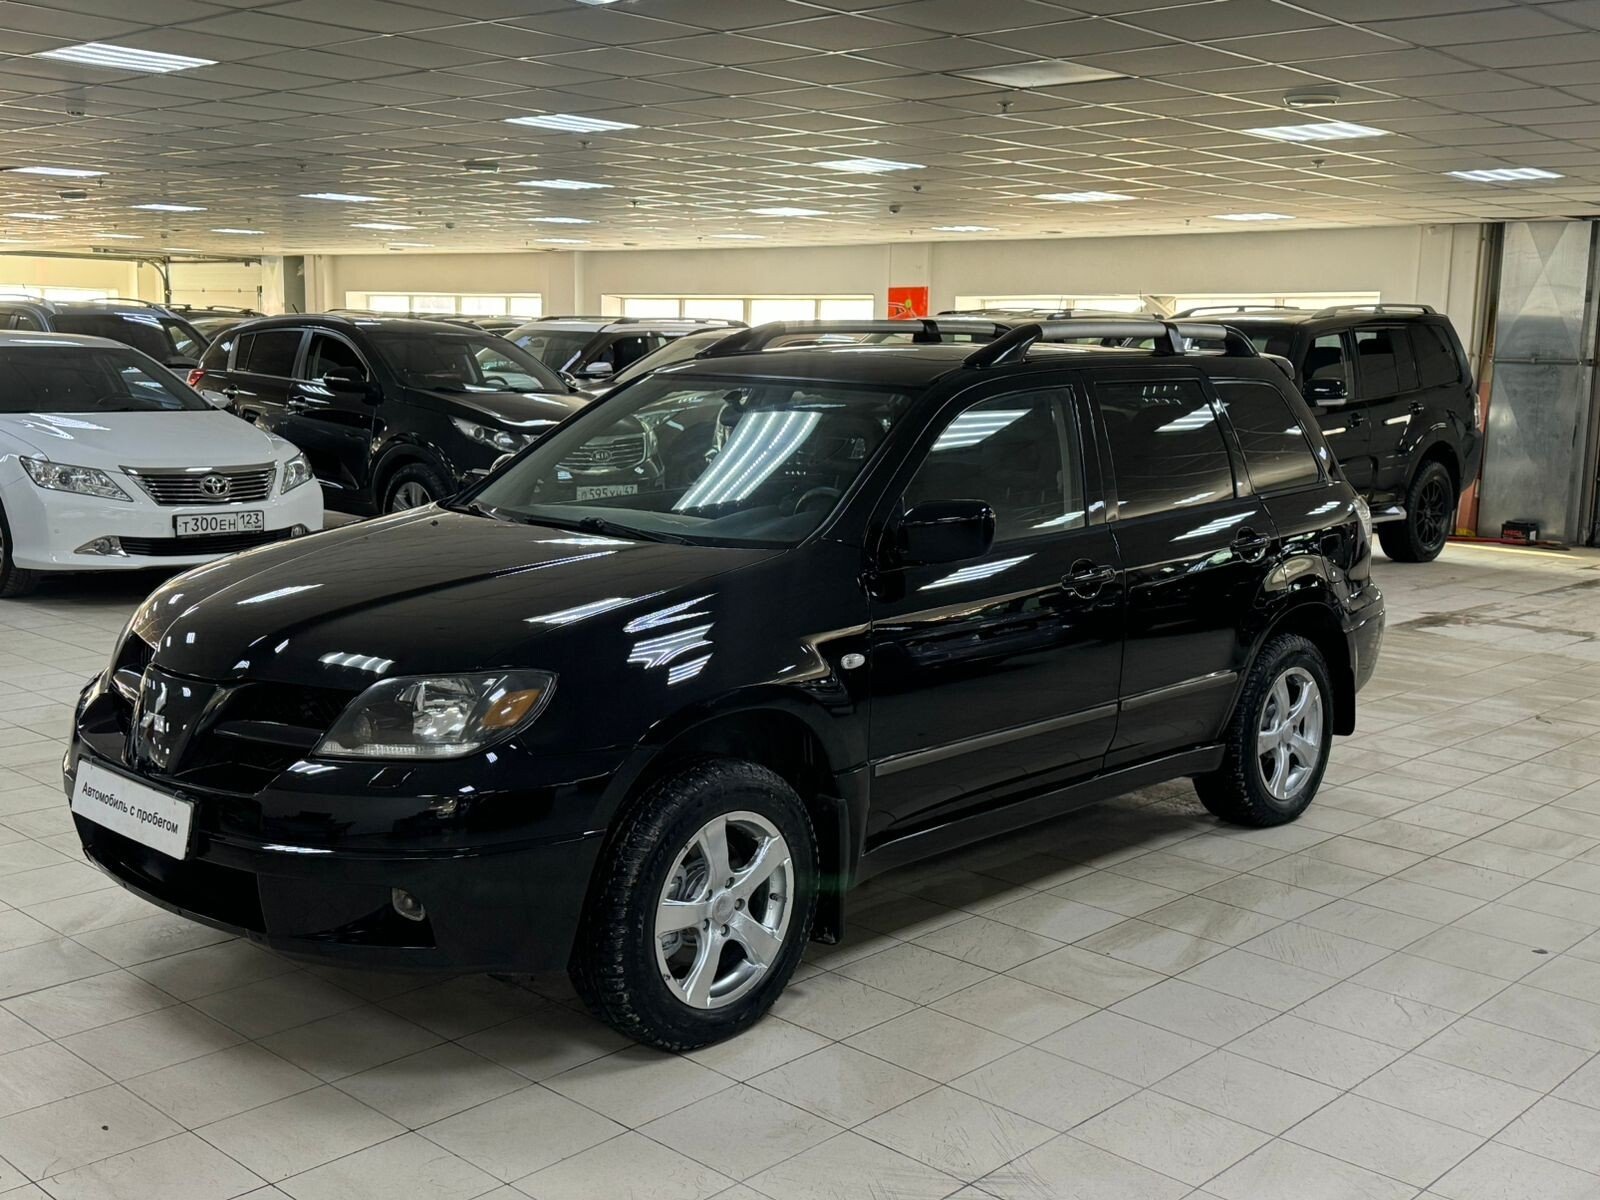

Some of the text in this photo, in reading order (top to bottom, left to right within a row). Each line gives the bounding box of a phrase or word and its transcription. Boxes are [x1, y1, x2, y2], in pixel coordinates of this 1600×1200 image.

[239, 513, 261, 526] 123
[82, 781, 178, 834] Автомобиль с пробегом
